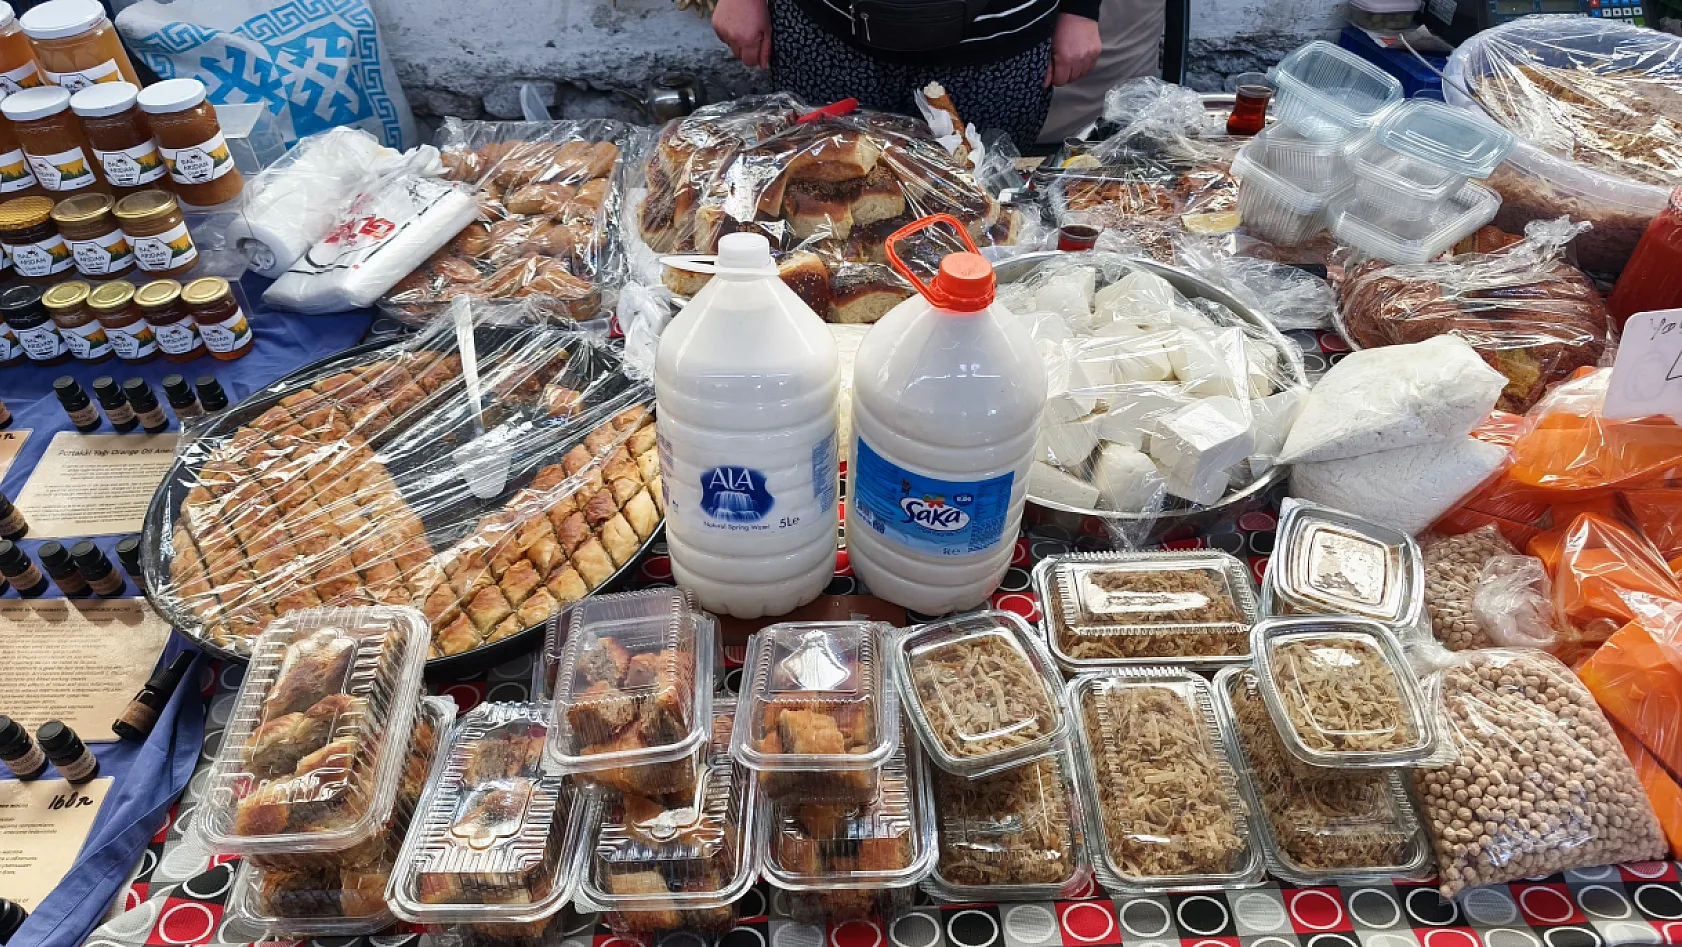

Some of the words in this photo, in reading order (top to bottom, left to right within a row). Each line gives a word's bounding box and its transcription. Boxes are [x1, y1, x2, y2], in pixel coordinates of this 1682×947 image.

[58, 449, 92, 457] Portakal
[111, 448, 139, 457] Orange
[141, 447, 153, 455] Oil
[709, 467, 754, 491] ALA
[901, 501, 960, 528] Saka
[704, 521, 725, 530] Natural
[728, 524, 749, 533] Spring
[48, 791, 79, 810] 160
